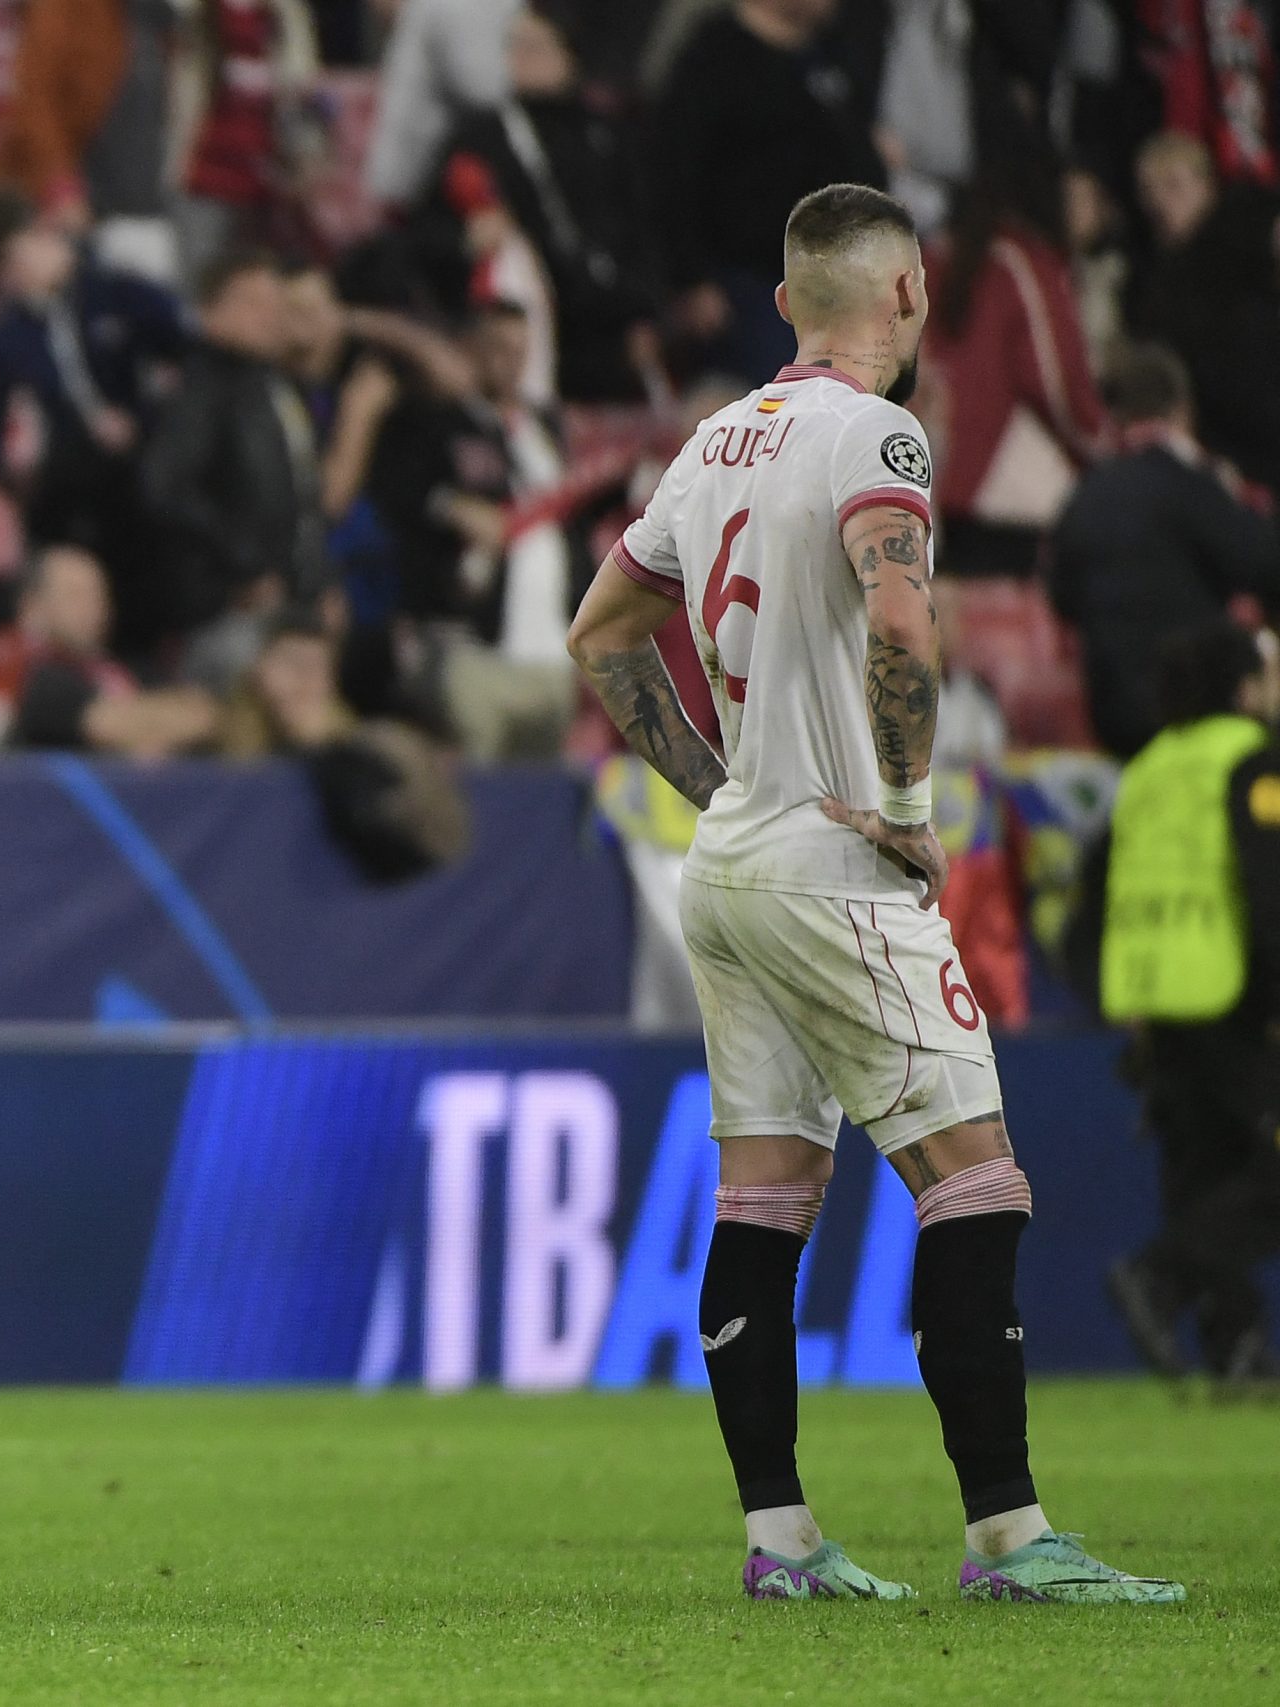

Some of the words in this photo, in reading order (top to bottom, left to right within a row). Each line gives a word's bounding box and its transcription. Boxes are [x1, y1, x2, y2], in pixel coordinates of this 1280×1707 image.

[703, 417, 795, 467] GULJ
[702, 508, 761, 704] 6
[939, 958, 979, 1031] 6
